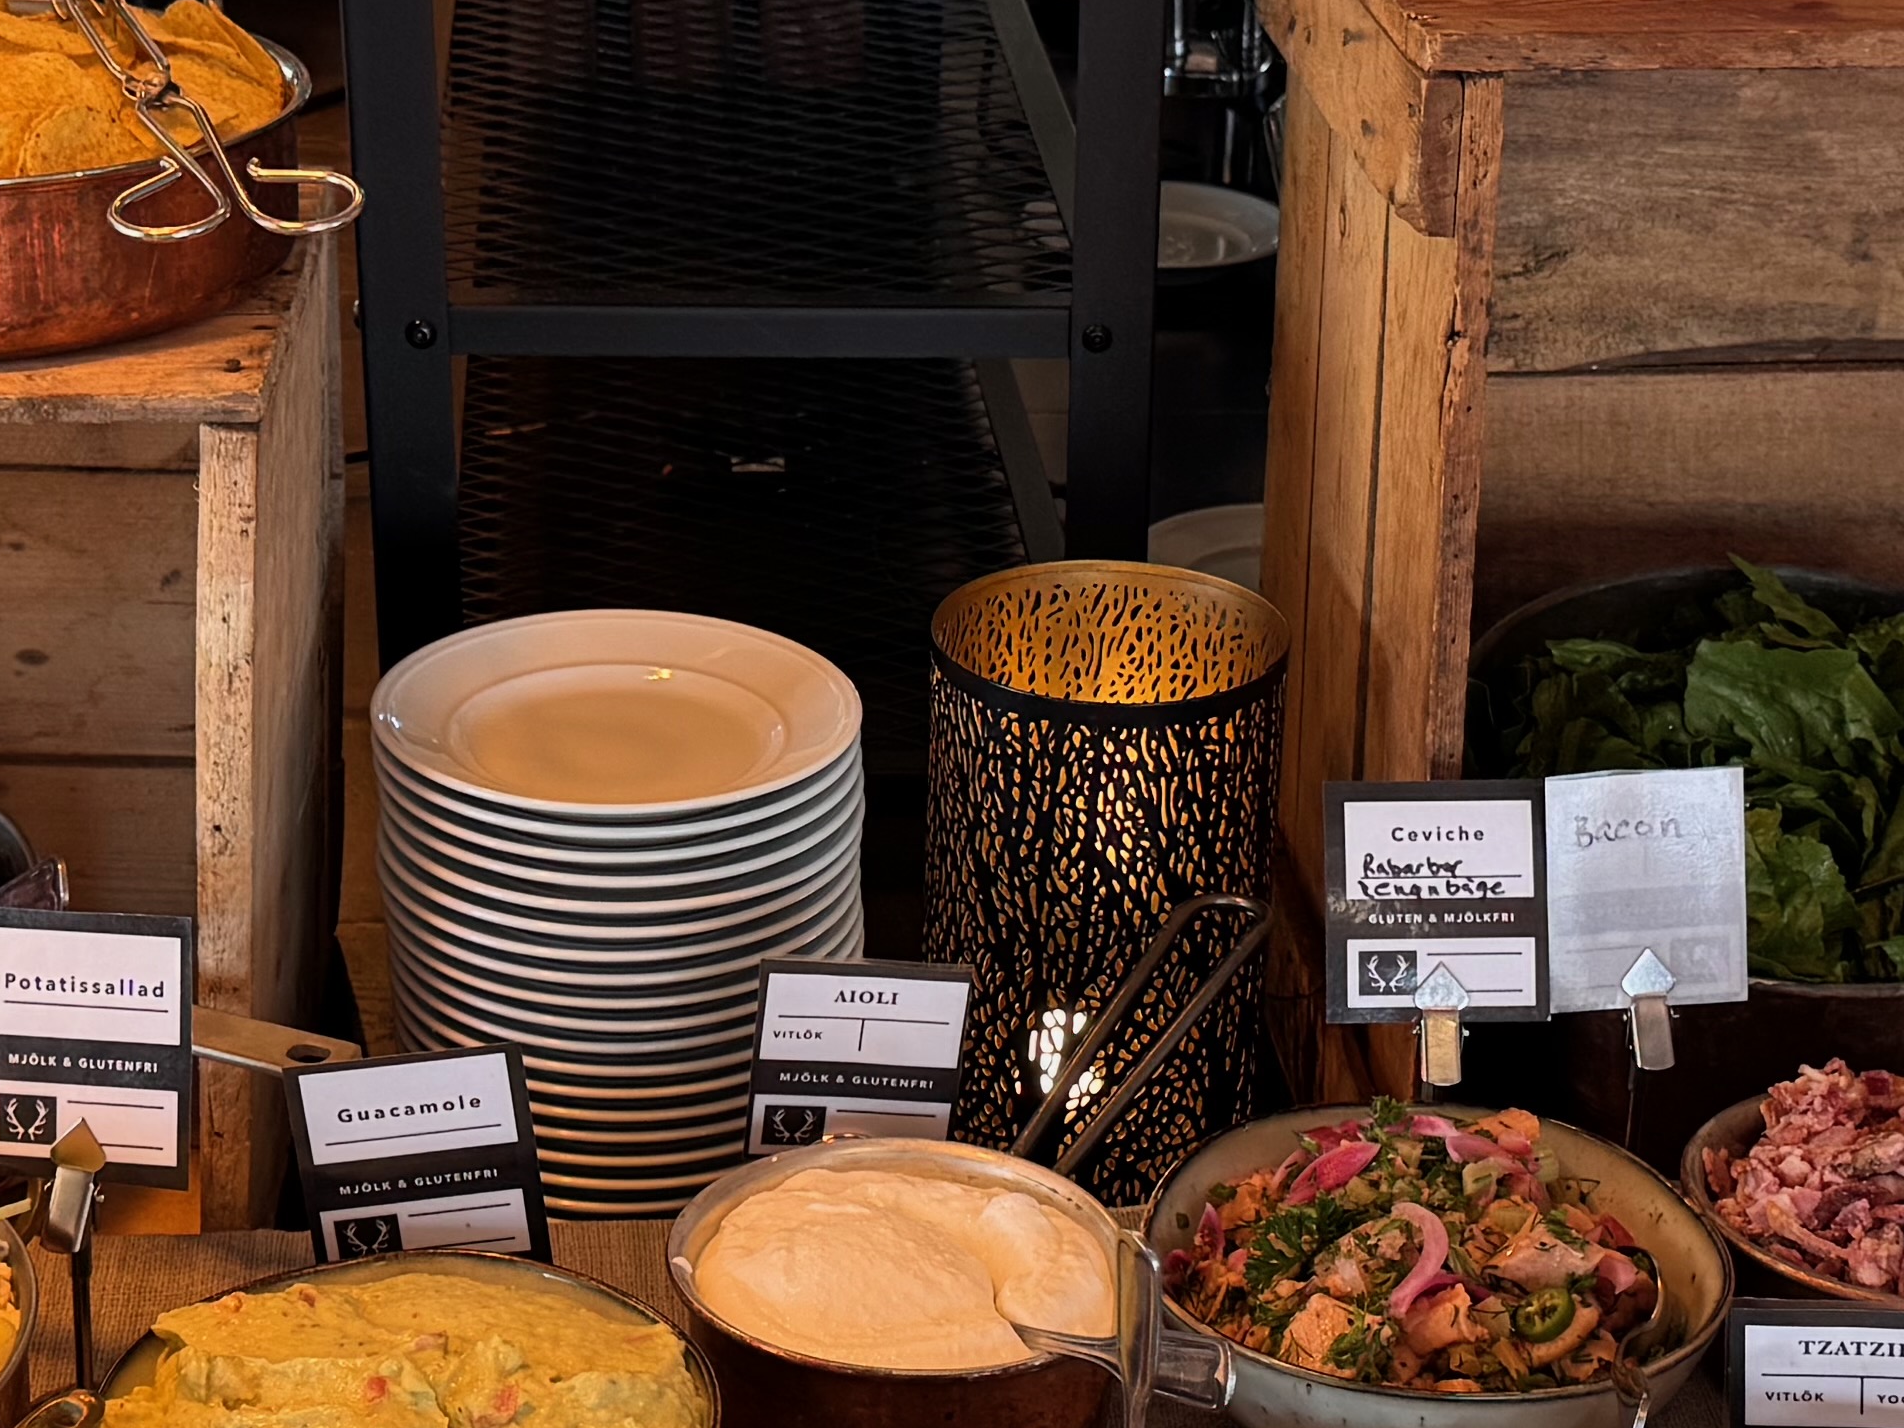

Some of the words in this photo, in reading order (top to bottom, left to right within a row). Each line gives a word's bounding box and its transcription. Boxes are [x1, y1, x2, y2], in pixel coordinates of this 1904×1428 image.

[1391, 825, 1484, 842] Ceviche
[1574, 815, 1683, 848] Bacon
[1368, 914, 1422, 924] GLUTEN
[1444, 911, 1515, 923] MJÖLKFRI
[5, 973, 165, 998] Potatissallad
[834, 990, 899, 1005] AIOLI
[773, 1029, 823, 1040] VITLÖK
[8, 1052, 57, 1067] MJÖLK
[78, 1057, 158, 1073] GLUTENFRI
[779, 1072, 829, 1083] MJÖLK
[852, 1075, 933, 1089] GLUTENFRI
[337, 1095, 481, 1123] Guacamole
[339, 1181, 391, 1196] MJÖLK
[414, 1168, 498, 1187] GLUTENFRI
[1765, 1390, 1824, 1402] VITLÖK
